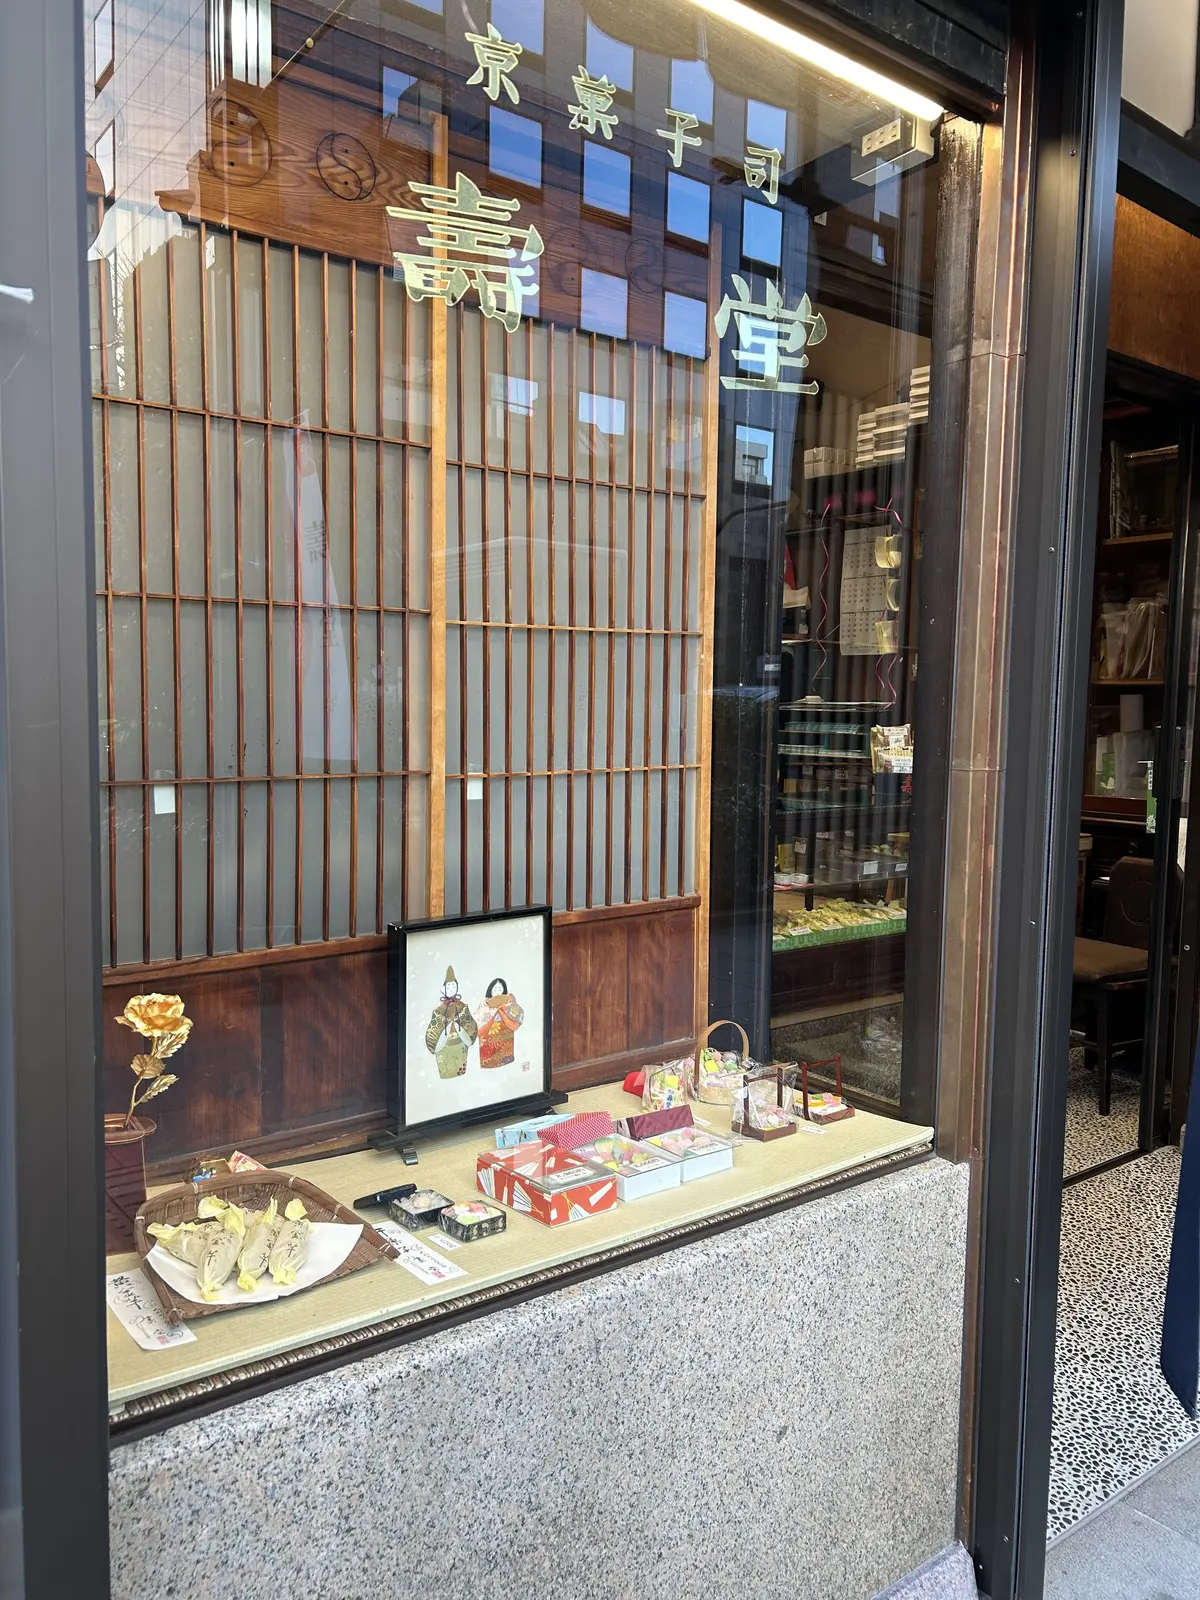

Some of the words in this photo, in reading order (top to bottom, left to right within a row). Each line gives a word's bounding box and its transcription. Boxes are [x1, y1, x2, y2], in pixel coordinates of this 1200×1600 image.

[464, 22, 781, 205] 京菓子司
[385, 171, 828, 395] 壽堂
